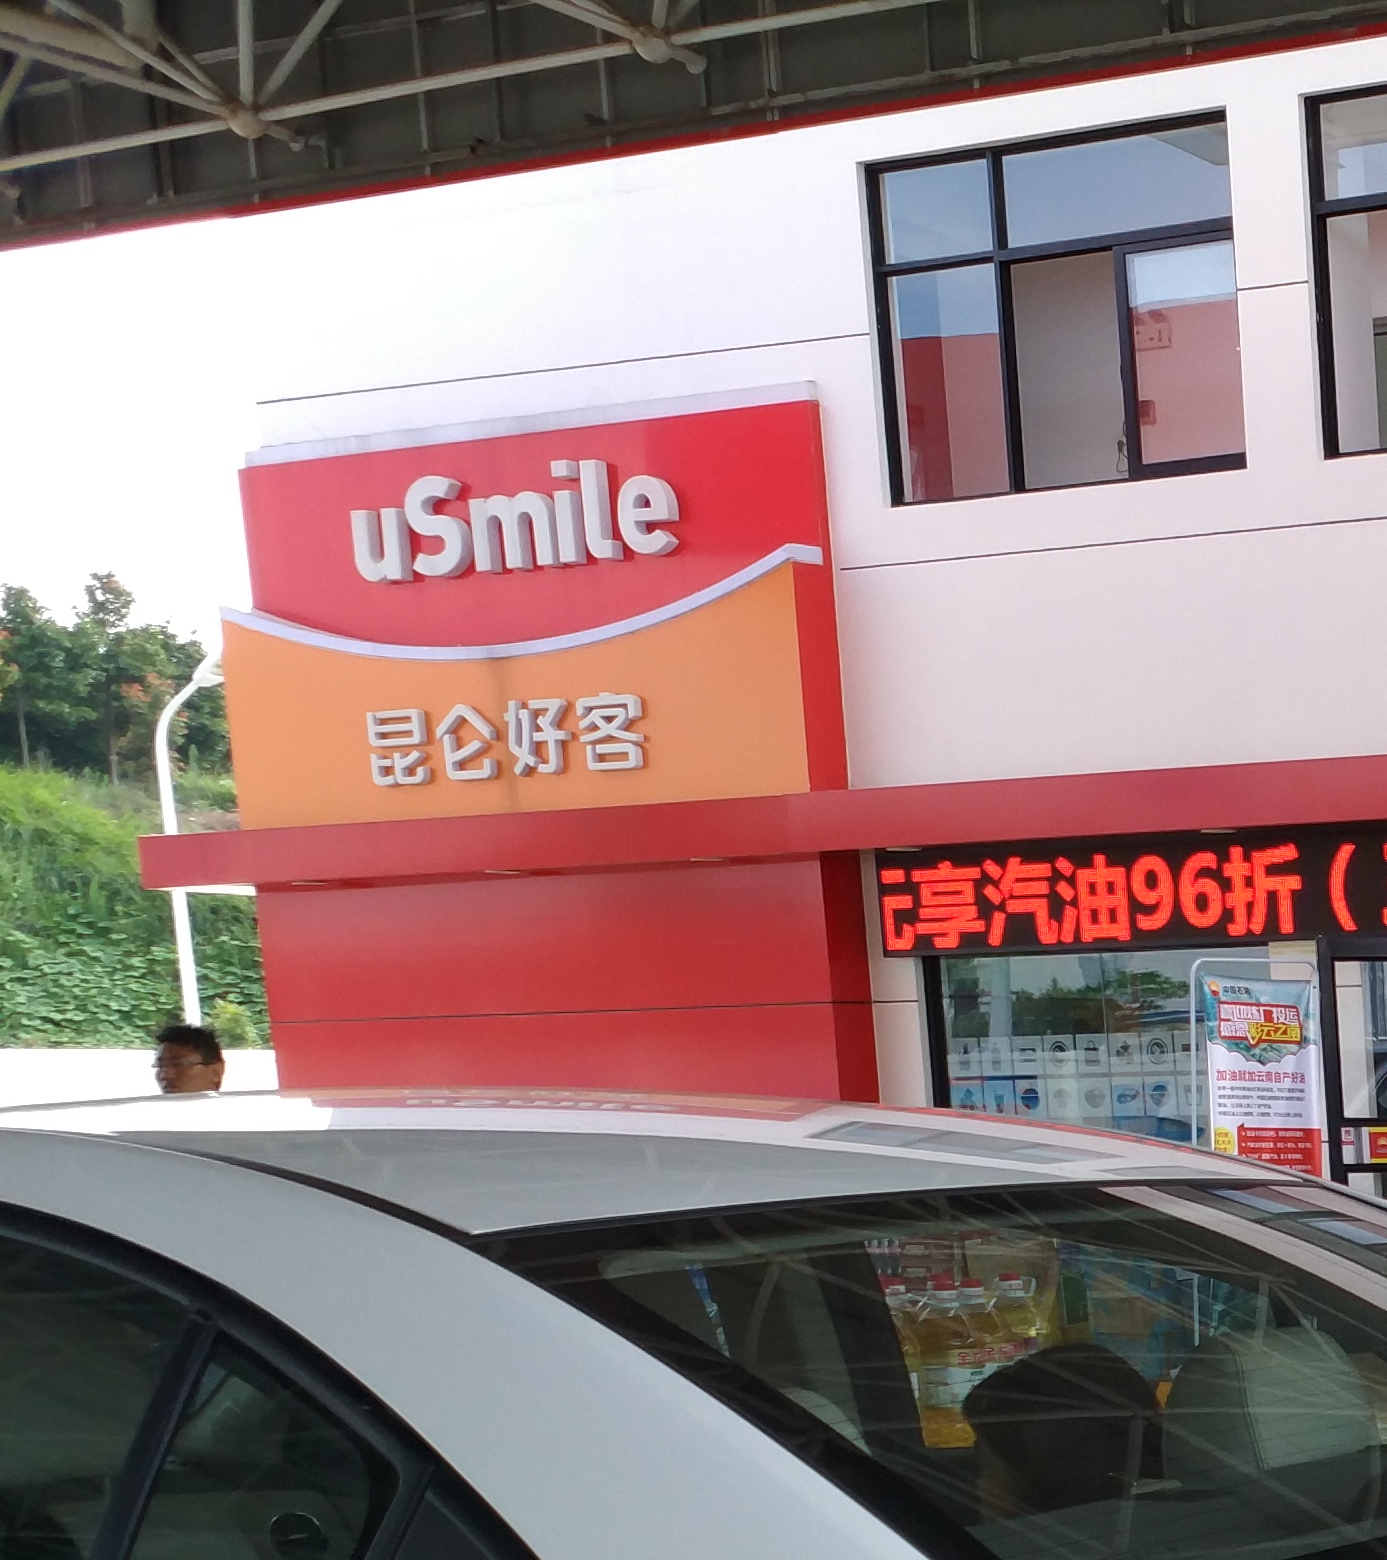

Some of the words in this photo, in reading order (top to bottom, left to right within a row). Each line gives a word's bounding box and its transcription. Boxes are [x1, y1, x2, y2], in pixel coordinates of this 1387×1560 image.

[350, 459, 681, 583] uSmile
[366, 692, 648, 786] 昆仑好客
